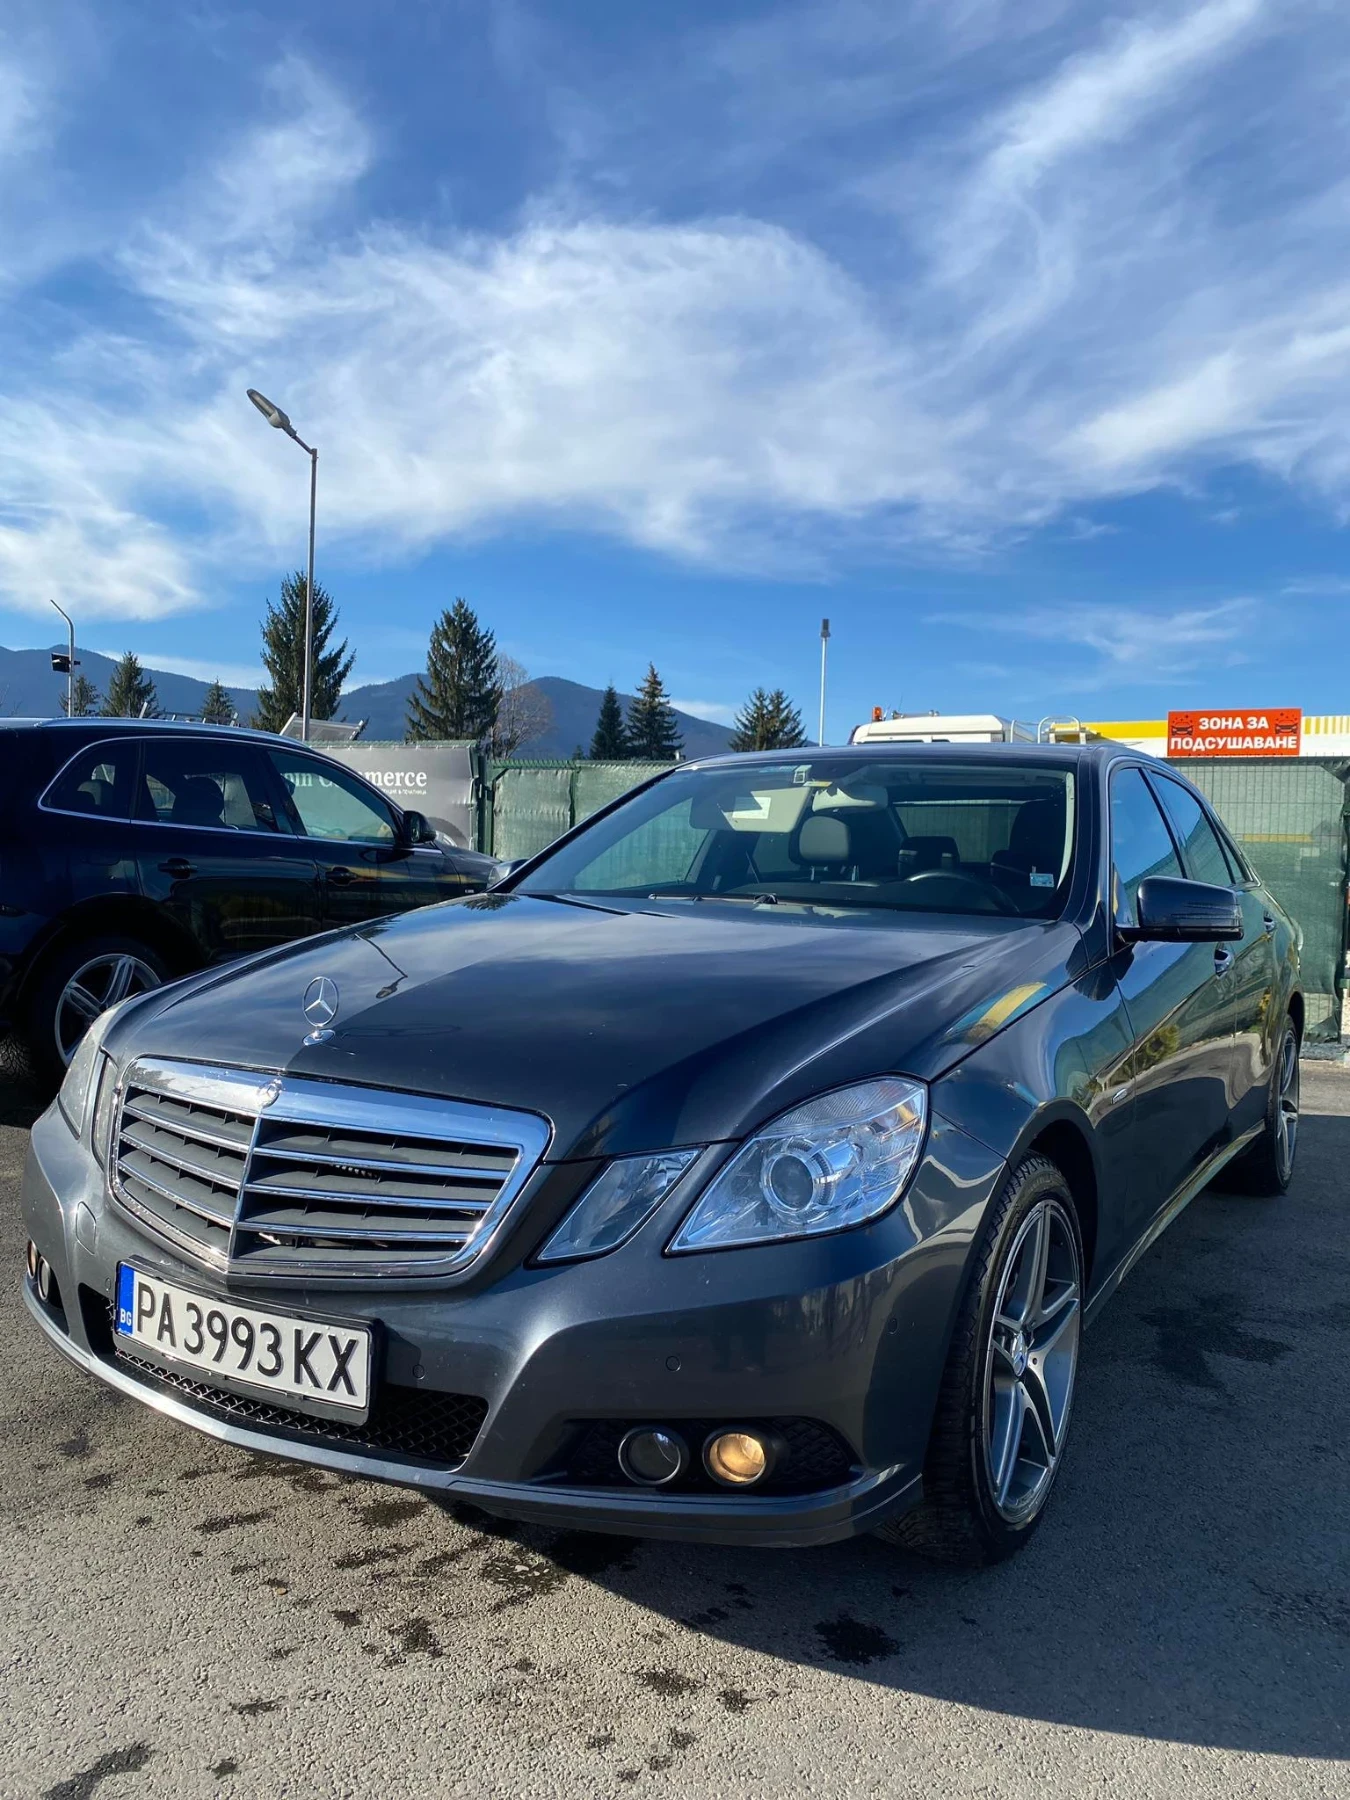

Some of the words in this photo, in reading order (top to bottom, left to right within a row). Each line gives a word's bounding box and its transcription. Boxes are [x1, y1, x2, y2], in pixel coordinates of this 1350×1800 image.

[1199, 717, 1244, 730] ЗОНА
[1247, 716, 1269, 729] ЗА
[1170, 736, 1298, 751] ПОДСУШАВАНЕ
[120, 1308, 132, 1327] BG
